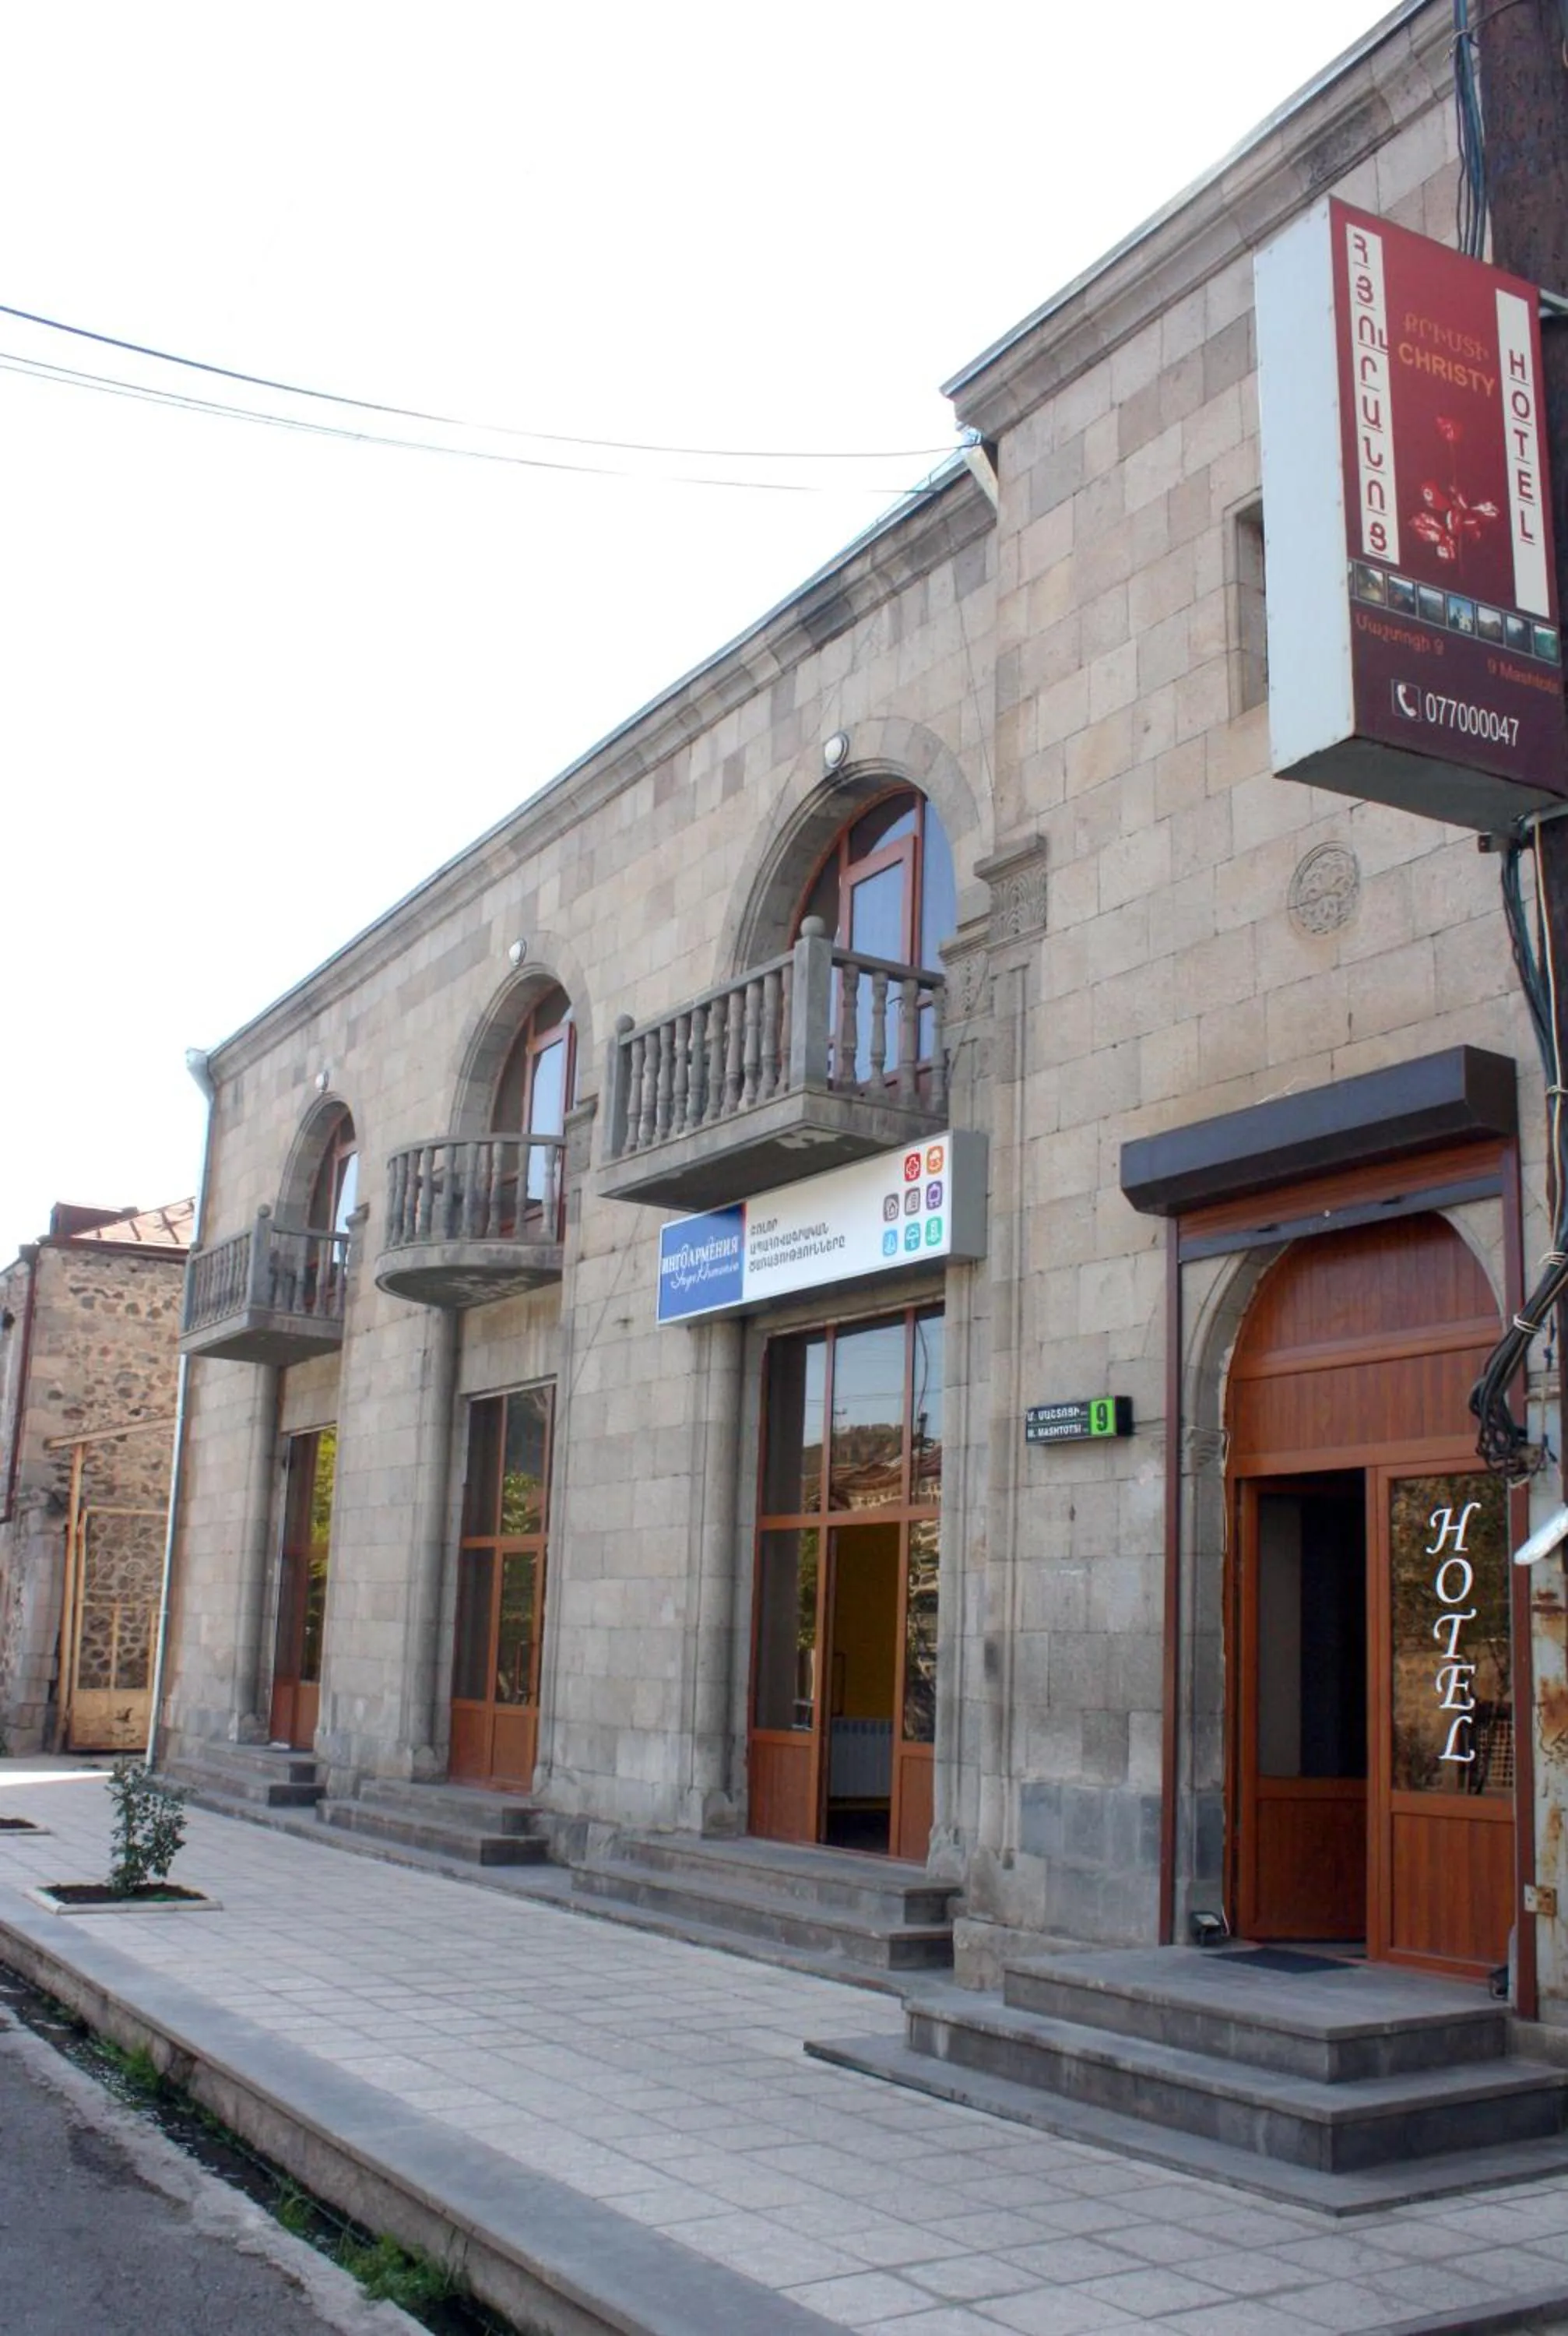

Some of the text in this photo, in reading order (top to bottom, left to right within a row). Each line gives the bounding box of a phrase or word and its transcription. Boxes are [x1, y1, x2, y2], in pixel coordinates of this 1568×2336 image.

[1398, 342, 1496, 398] CHRISTY
[1508, 349, 1535, 544] HOTEL
[1425, 692, 1520, 748] 077000047
[1038, 1423, 1081, 1437] MASHTOTSI
[1096, 1402, 1109, 1431] 9
[1426, 1501, 1480, 1762] HOTEL
